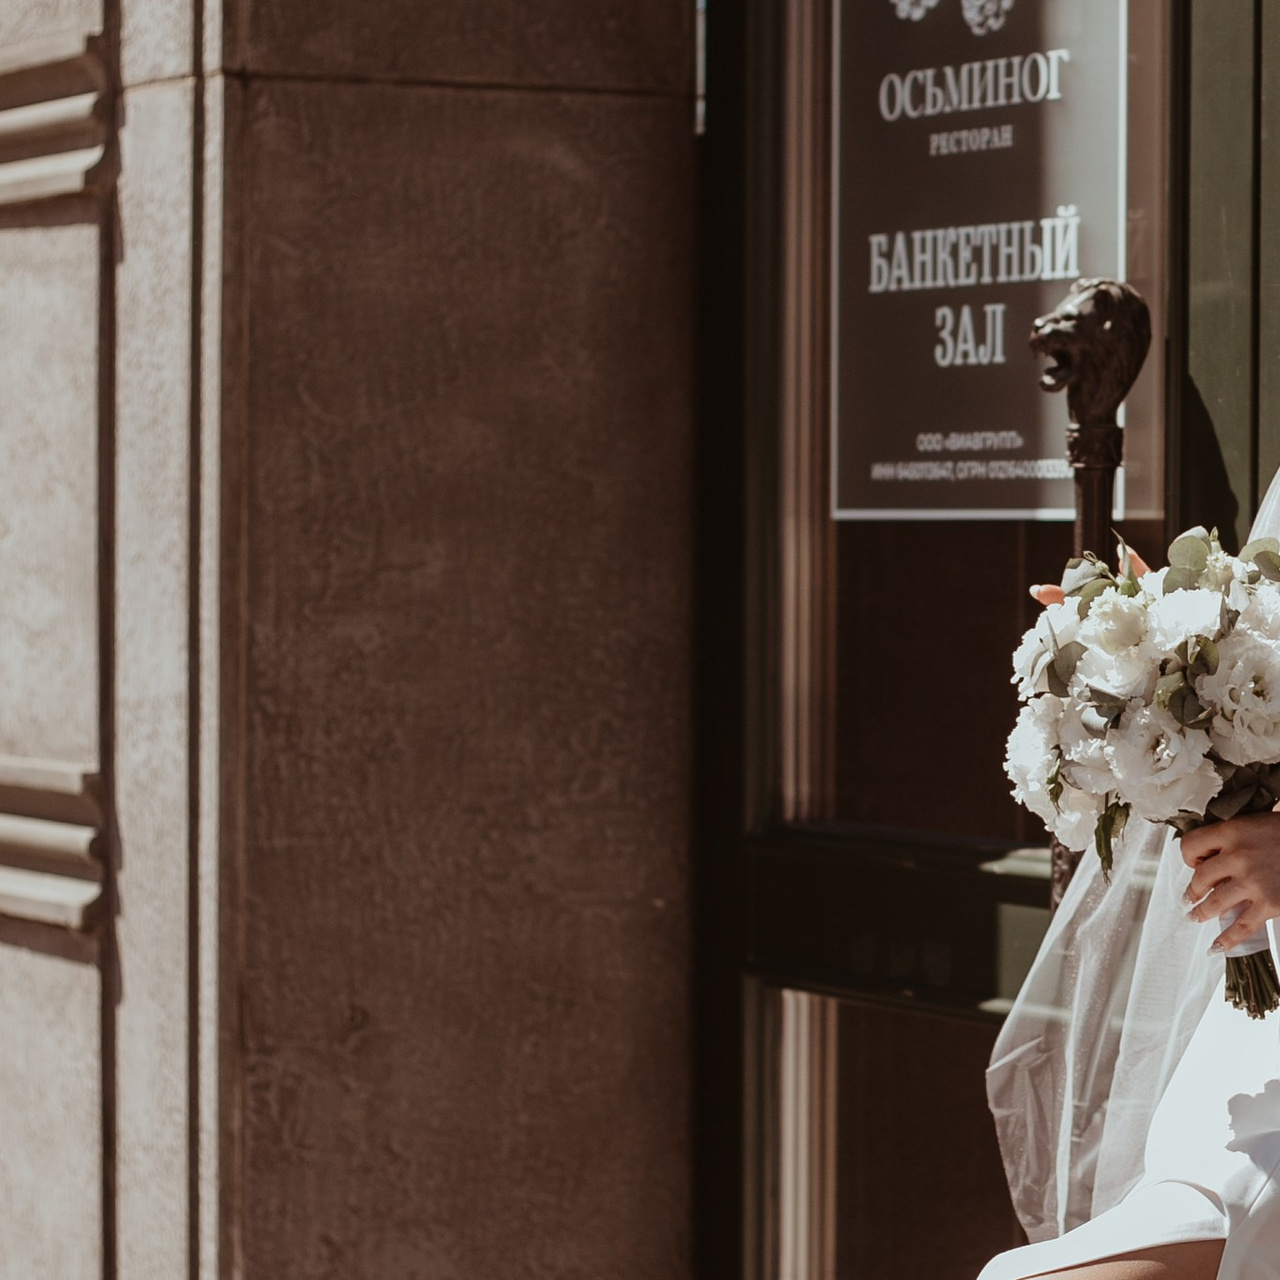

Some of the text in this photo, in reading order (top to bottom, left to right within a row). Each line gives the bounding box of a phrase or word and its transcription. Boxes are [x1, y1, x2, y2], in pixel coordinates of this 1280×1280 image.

[879, 49, 1070, 121] ОСЬМИНОГ
[930, 125, 1013, 155] РЕСТОРАН
[868, 204, 1080, 293] БАНКЕТНЫЙ
[934, 303, 1006, 367] ЗАЛ
[916, 432, 943, 452] ООО
